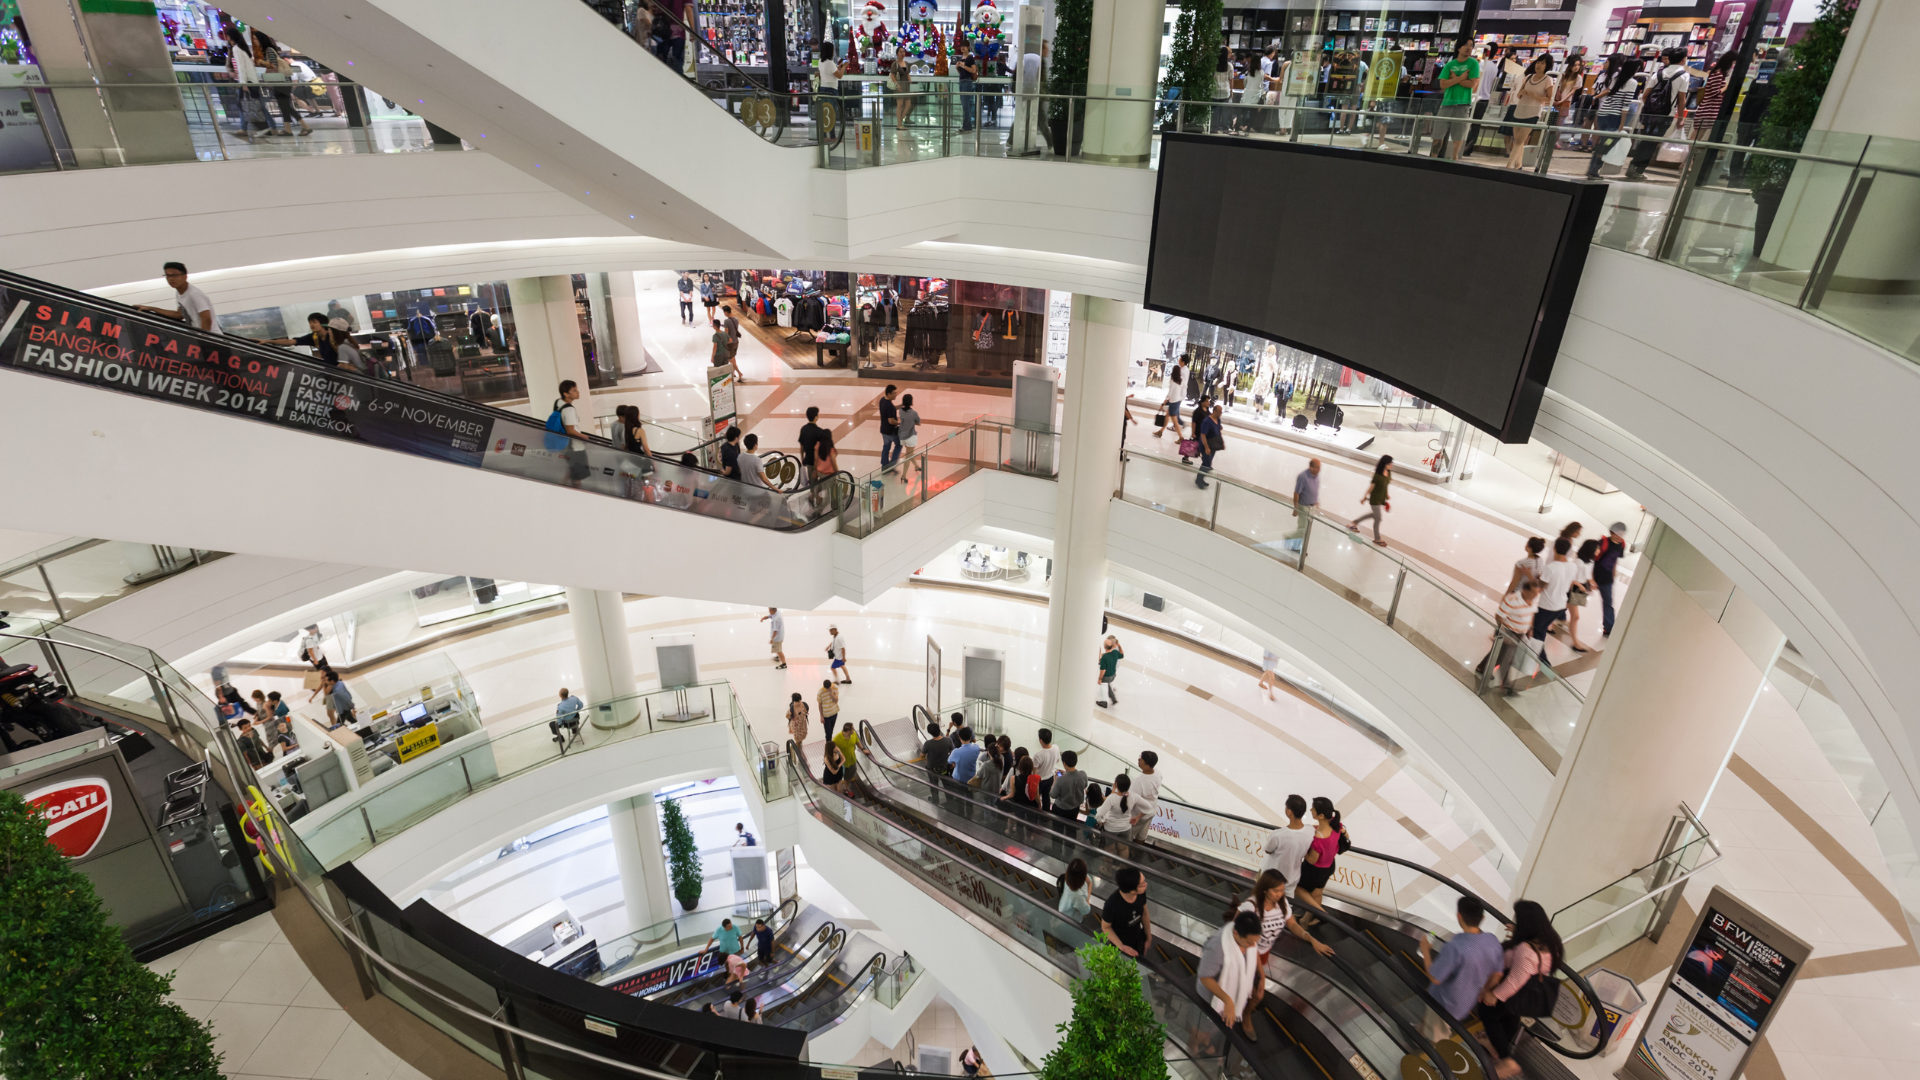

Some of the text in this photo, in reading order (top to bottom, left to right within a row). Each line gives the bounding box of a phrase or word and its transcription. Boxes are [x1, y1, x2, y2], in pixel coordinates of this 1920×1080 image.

[762, 104, 770, 123] 3
[824, 106, 830, 128] 3
[36, 305, 280, 378] SIAM PARAGON
[28, 325, 272, 396] BANGKOK INTERNATIONAL
[22, 344, 268, 415] FASHION WEEK 2014
[300, 374, 354, 398] DIGITAL
[294, 399, 334, 418] WEEK
[289, 411, 354, 434] BANGKOK
[401, 406, 484, 438] NOVEMBER
[785, 466, 792, 481] 2
[676, 484, 690, 494] true
[1752, 949, 1770, 963] WEEK
[1756, 941, 1783, 960] DIGITAL
[1749, 953, 1781, 976] BANGKOK
[1678, 999, 1699, 1017] SIAM
[1698, 1015, 1738, 1047] PARAGON
[1659, 1038, 1686, 1060] ANOC
[1688, 1060, 1714, 1080] 2014
[1662, 1029, 1718, 1076] BANGKOK
